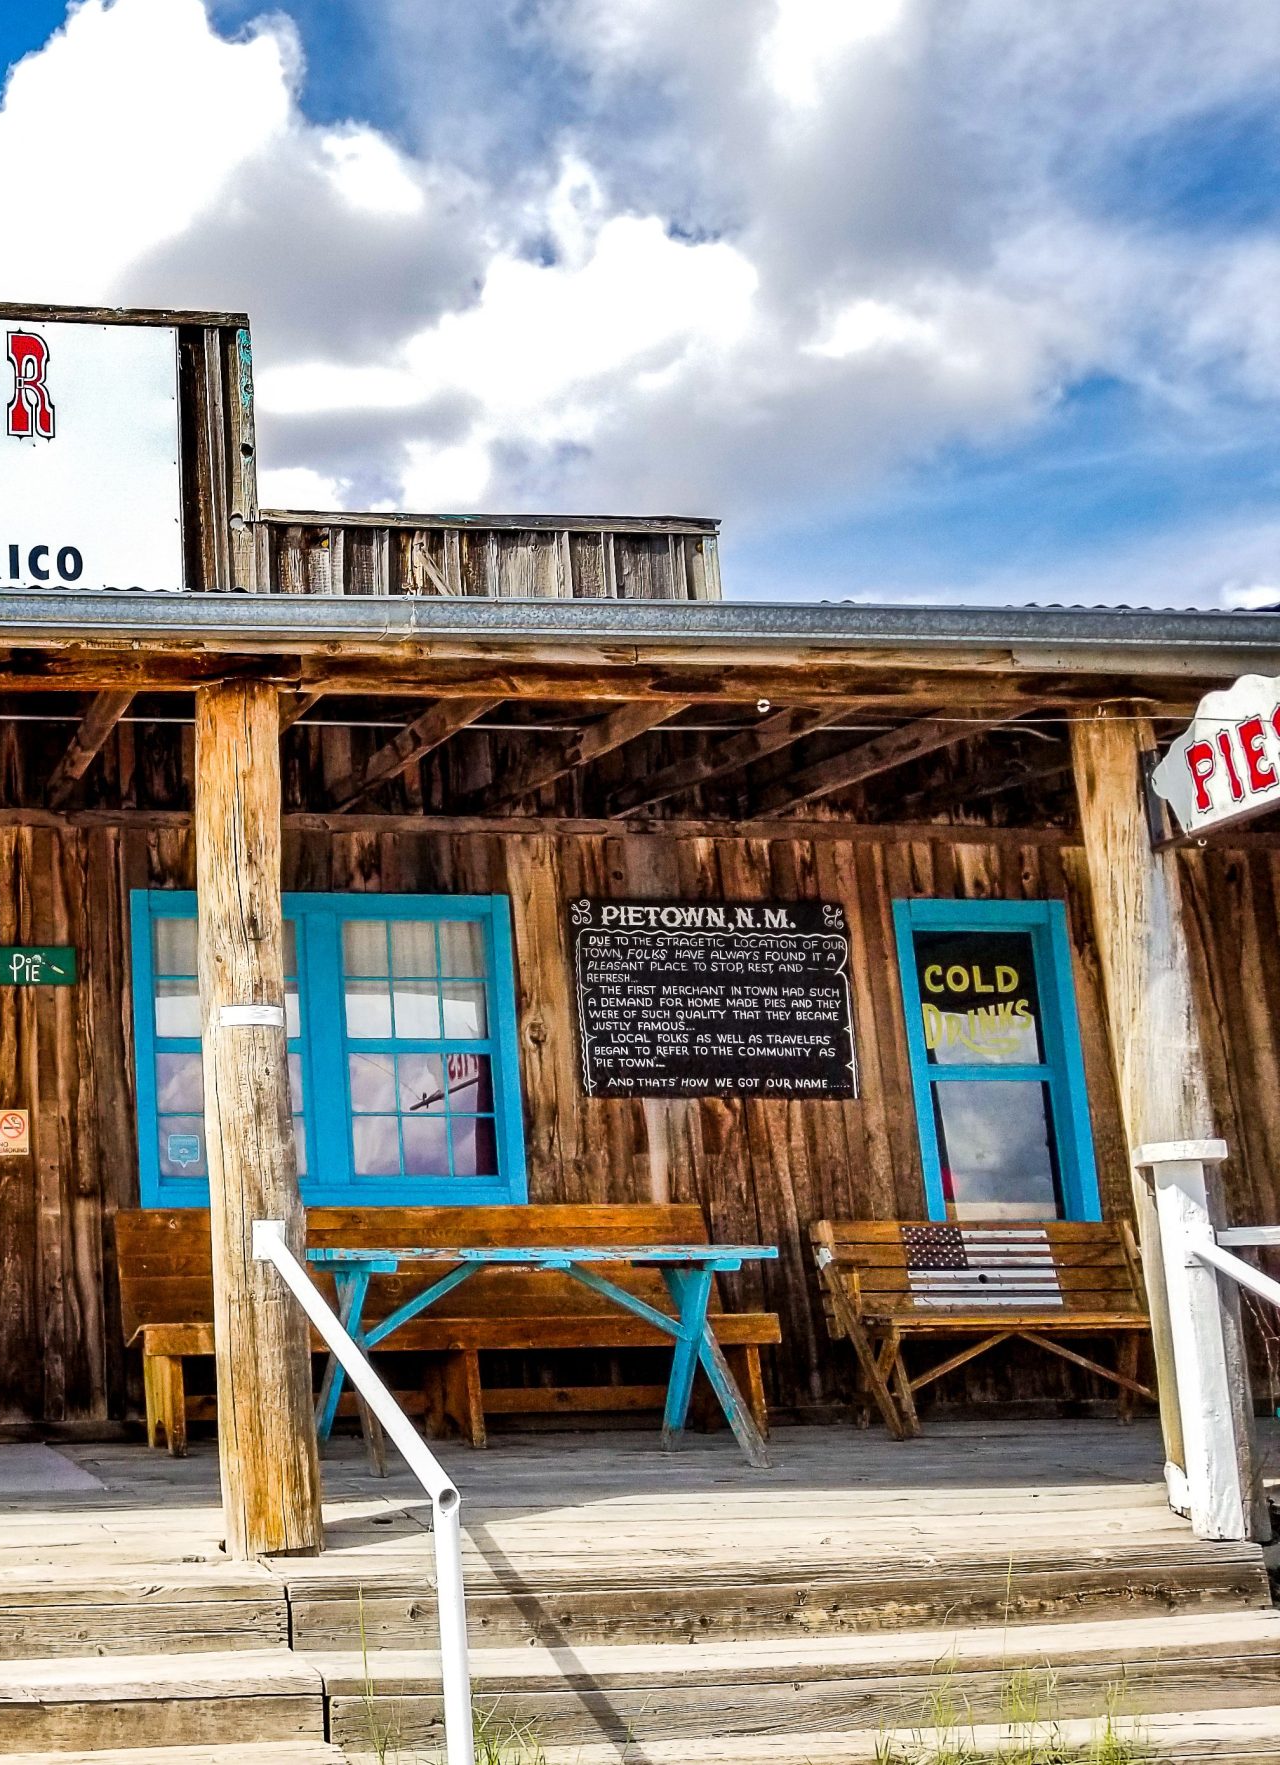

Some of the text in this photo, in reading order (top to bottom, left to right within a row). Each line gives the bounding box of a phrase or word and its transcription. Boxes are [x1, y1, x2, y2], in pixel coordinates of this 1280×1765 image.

[1185, 702, 1280, 814] PIE
[589, 936, 845, 951] DUE TO THE STRAGETIC LOCATION OF OUR
[583, 947, 836, 962] TOWN, FOLKS HAVE ALWAYS FOUND IT A
[587, 961, 804, 974] PLEASANT PLACE TO STOP, REST, AND
[924, 965, 1019, 993] COLD
[600, 985, 839, 997] THE FIRST MERCHANT IN TOWN HAD SUCH
[588, 997, 841, 1009] A DEMAND FOR HOME MADE PIES AND THEY
[588, 1010, 840, 1021] WERE OF SUCH QUALITY THAT THEY BECAME
[592, 1021, 631, 1031] JUSTLY
[922, 999, 1033, 1055] DRINKS
[611, 1033, 832, 1045] LOCAL FOLKS AS WELL AS TRAVELERS
[594, 1046, 836, 1057] BEGAN TO REFER TO THE COMMUNITY AS
[607, 1078, 634, 1087] AND
[681, 1078, 709, 1088] HOW
[715, 1078, 733, 1087] WE
[738, 1078, 760, 1088] GOT
[766, 1078, 792, 1089] OUR
